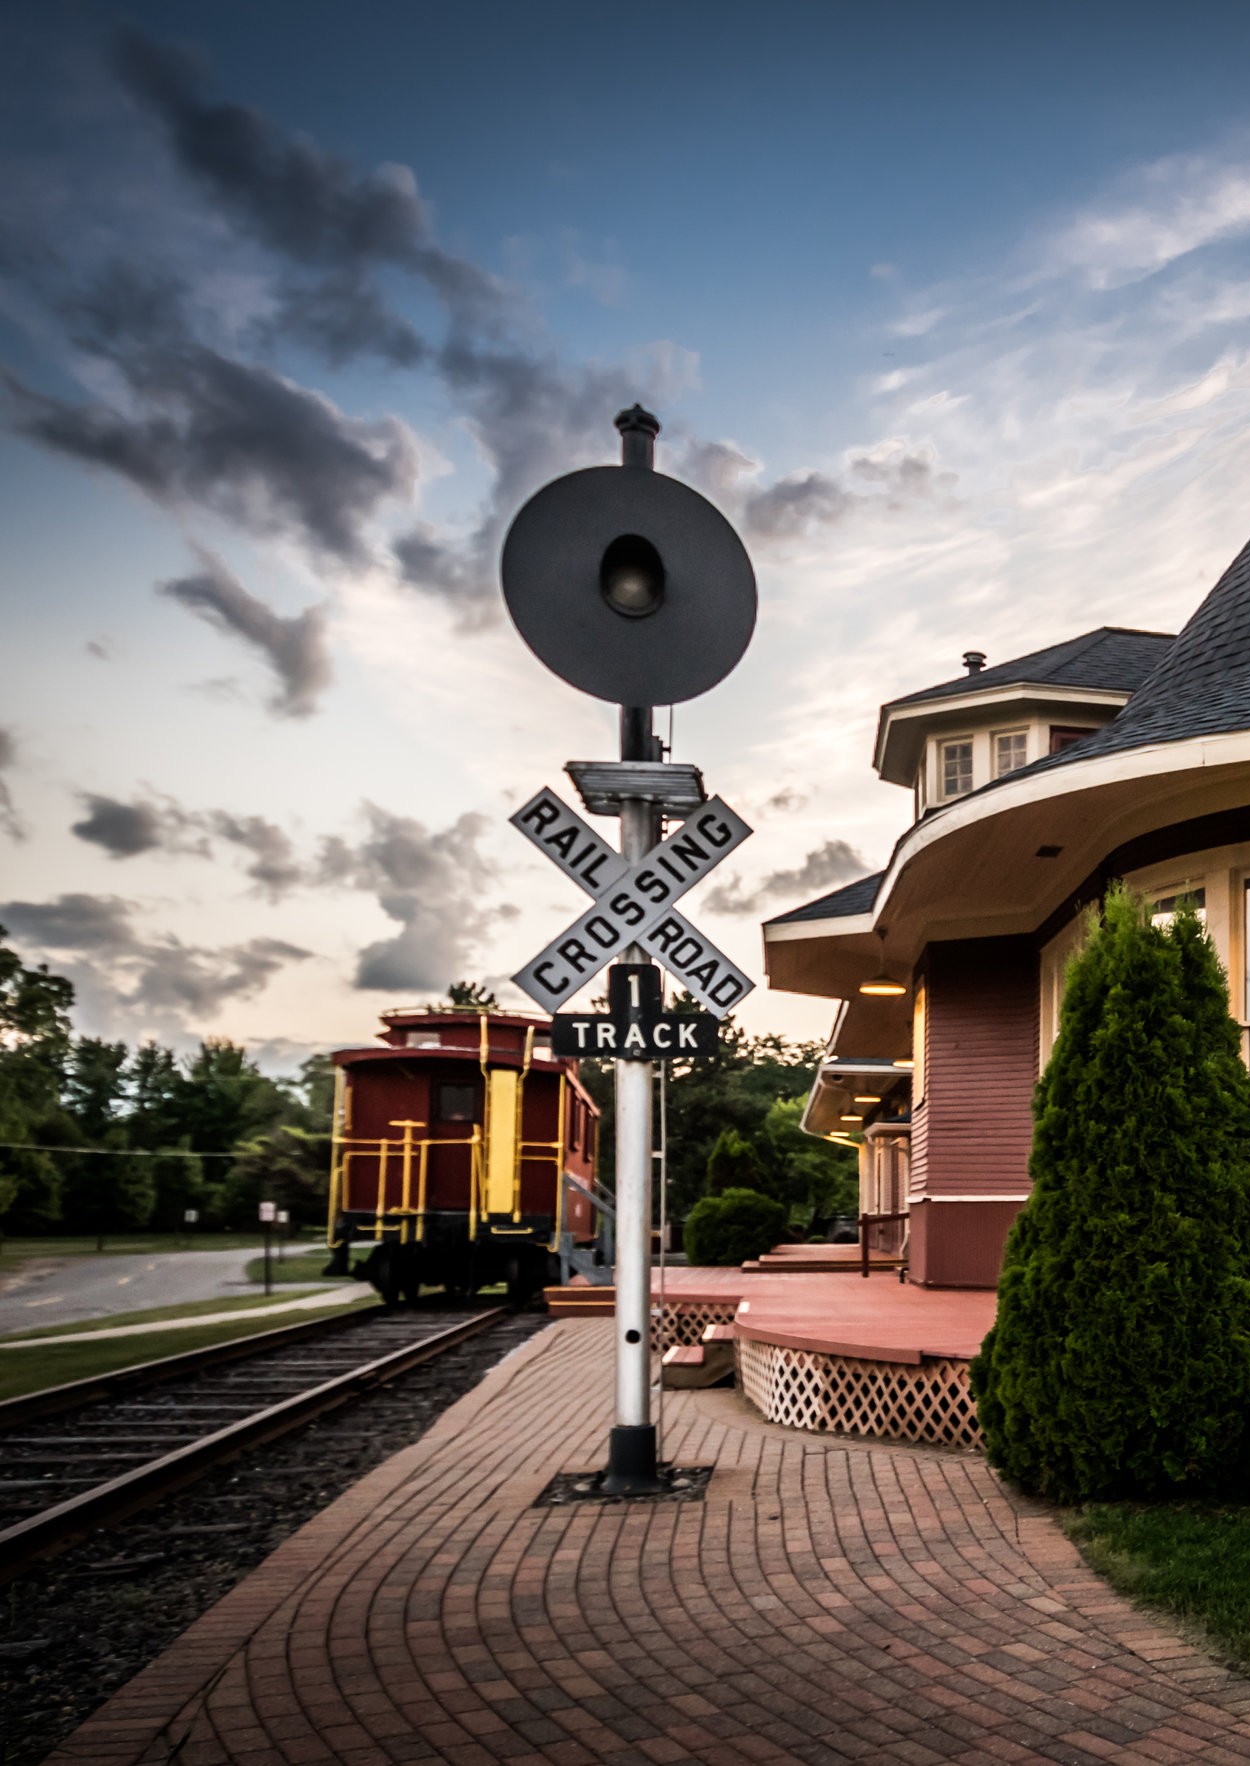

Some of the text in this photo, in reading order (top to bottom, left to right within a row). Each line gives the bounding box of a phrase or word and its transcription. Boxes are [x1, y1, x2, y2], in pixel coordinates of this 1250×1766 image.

[521, 798, 744, 1008] RAIL ROAD
[532, 813, 732, 996] CROSSING
[572, 1022, 699, 1049] TRACK
[627, 974, 640, 1008] 1
